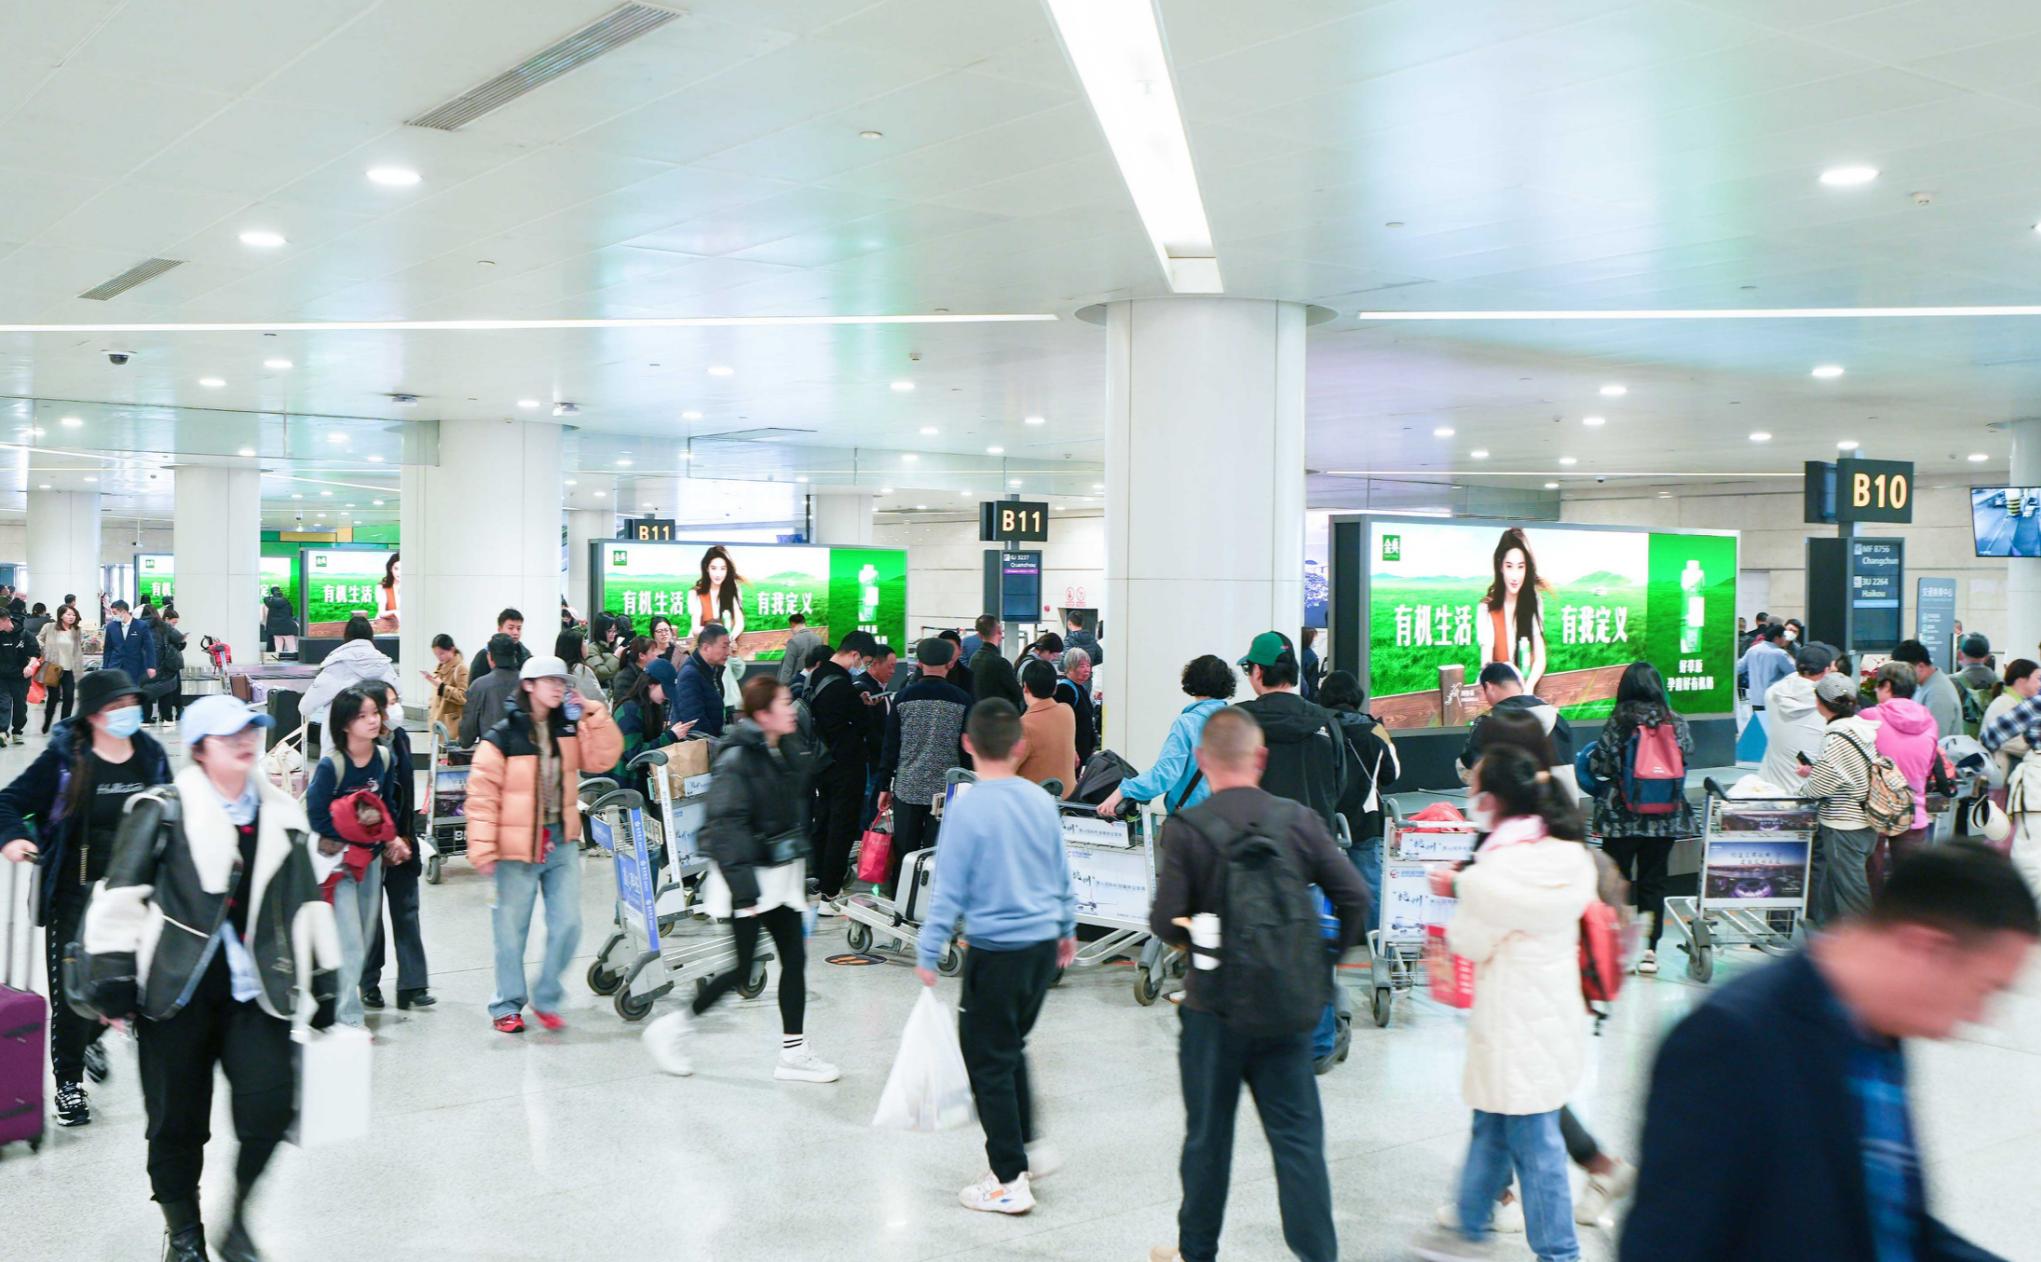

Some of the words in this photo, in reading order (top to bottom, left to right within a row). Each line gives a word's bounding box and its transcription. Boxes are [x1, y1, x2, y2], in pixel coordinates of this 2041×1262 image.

[1853, 473, 1907, 509] B10
[639, 525, 669, 541] B11
[1002, 510, 1040, 532] B11
[323, 585, 373, 604] 有机生活
[623, 589, 684, 616] 有机生活
[757, 591, 814, 616] 有我定义
[1394, 604, 1473, 647] 有机生活
[1561, 604, 1629, 644] 有我定义
